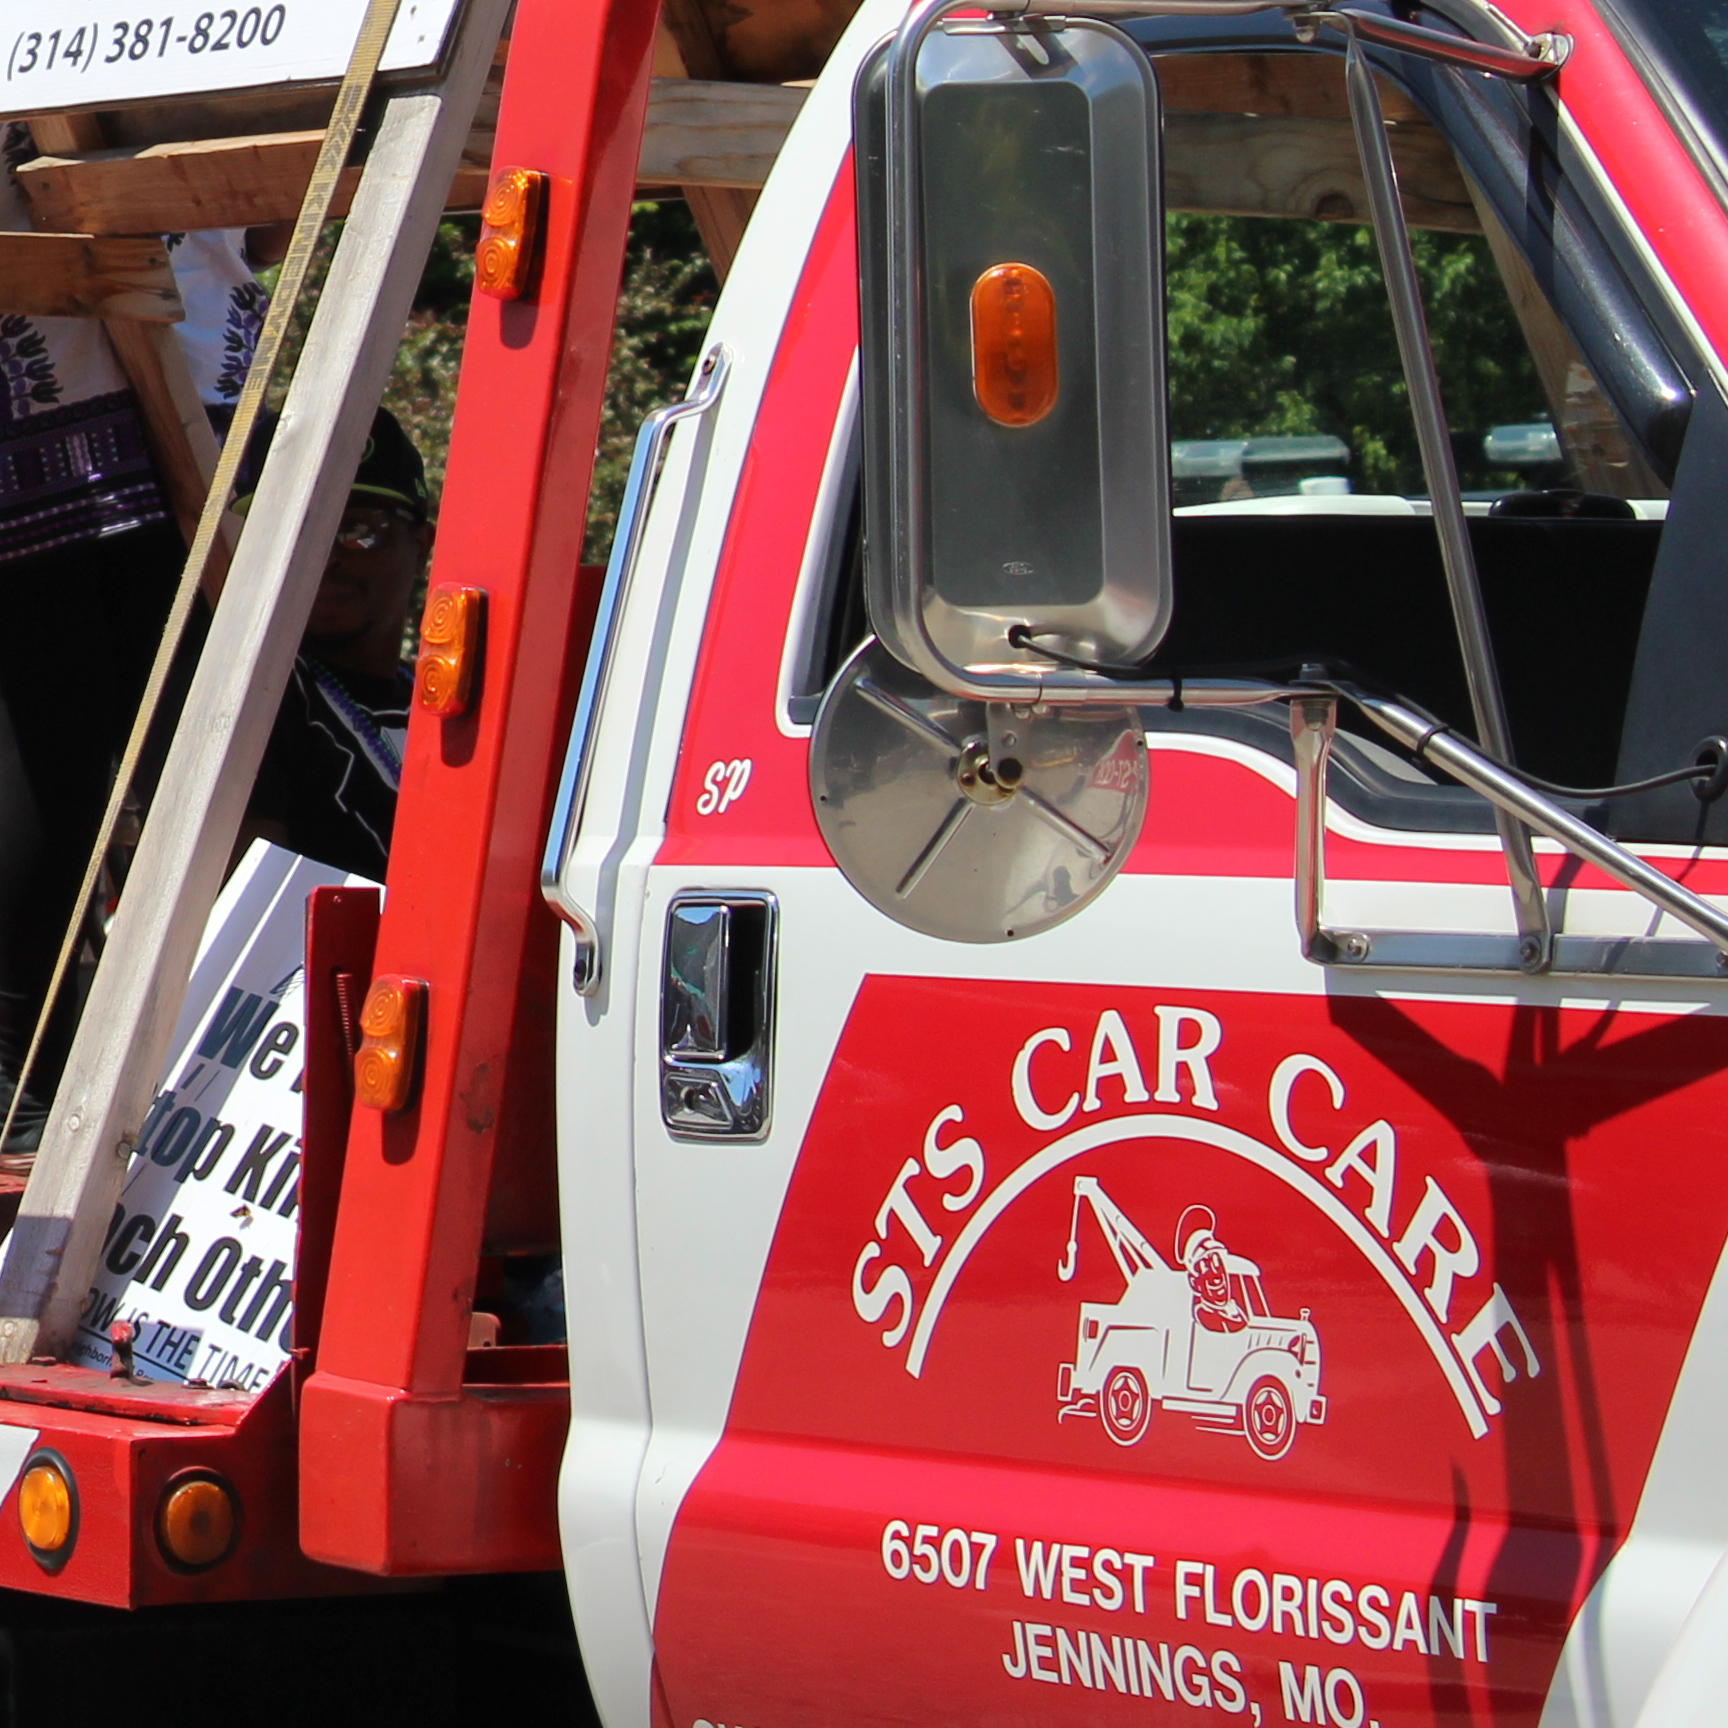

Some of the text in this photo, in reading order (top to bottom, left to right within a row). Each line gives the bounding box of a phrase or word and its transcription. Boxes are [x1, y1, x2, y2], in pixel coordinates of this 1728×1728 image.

[5, 22, 100, 83] (314)
[104, 3, 287, 65] 381-8200
[197, 986, 299, 1080] We
[135, 1088, 236, 1183] top
[851, 1004, 1543, 1418] STS CAR CARE
[100, 1201, 294, 1354] ch Oth
[82, 1287, 125, 1329] OW
[146, 1320, 201, 1371] THE
[879, 1517, 1497, 1663] 6507 WEST FLORISSANT
[1001, 1619, 1382, 1728] JENNINGS, MO.
